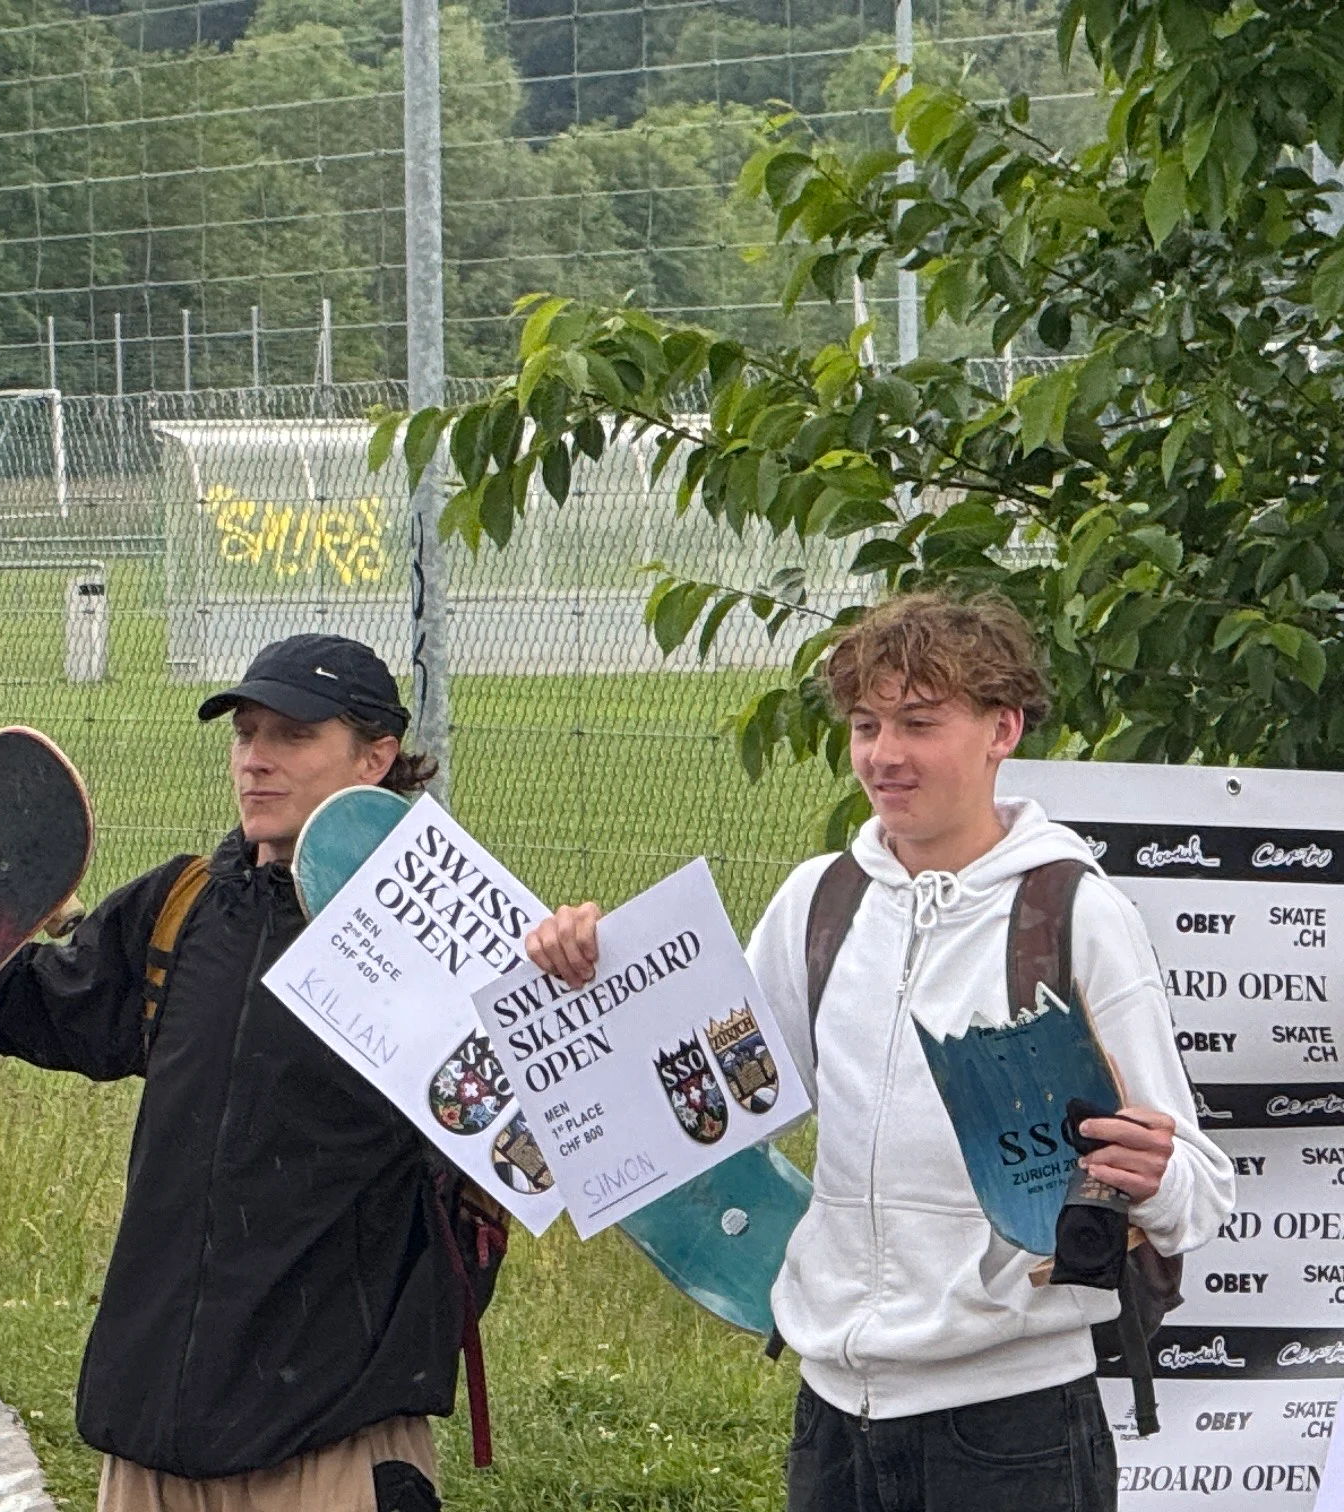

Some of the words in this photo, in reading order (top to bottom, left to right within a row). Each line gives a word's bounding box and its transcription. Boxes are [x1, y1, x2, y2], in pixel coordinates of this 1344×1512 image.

[416, 825, 532, 941] SWISS
[352, 906, 383, 938] MEN
[375, 878, 473, 976] OPEN
[394, 850, 524, 976] SKATE
[1176, 912, 1236, 935] OBEY
[1268, 906, 1327, 926] SKATE
[1292, 929, 1326, 948] .CH
[329, 934, 358, 962] CHF
[355, 959, 380, 985] 400
[358, 934, 403, 982] PLACE
[494, 974, 573, 1028] SWI
[509, 929, 702, 1062] SKATEBOARD
[1238, 973, 1329, 1002] OPEN
[298, 967, 399, 1068] KILIAN
[1177, 1032, 1237, 1052] OBEY
[1271, 1025, 1333, 1044] SKATE
[463, 1041, 515, 1097] SSO
[525, 1024, 614, 1092] OPEN
[660, 1048, 705, 1089] SSO
[1302, 1045, 1338, 1063] .CH
[544, 1101, 570, 1124] MEN
[565, 1103, 605, 1132] PLACE
[559, 1136, 581, 1157] CHF
[583, 1125, 604, 1144] 800
[583, 1151, 655, 1205] SIMON
[1012, 1162, 1061, 1186] ZURICH
[1205, 1273, 1269, 1294] OBEY
[1195, 1411, 1253, 1432] OBEY
[1282, 1401, 1338, 1419] SKATE
[1300, 1420, 1333, 1439] .CH
[1117, 1465, 1233, 1495] EBOARD
